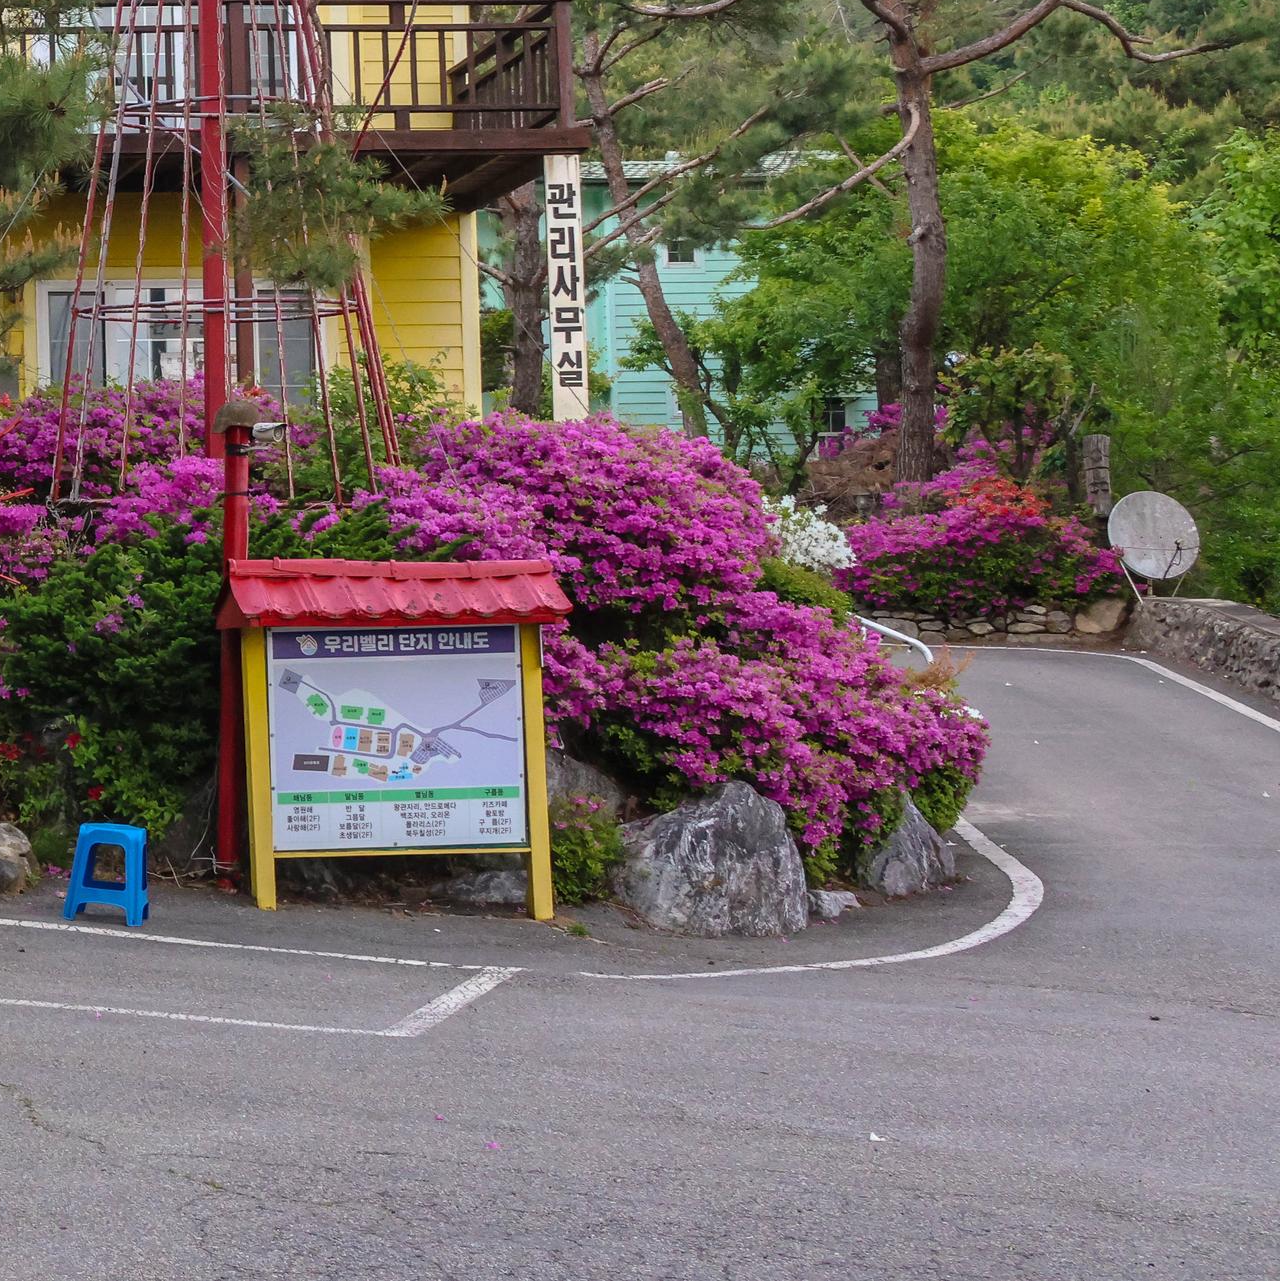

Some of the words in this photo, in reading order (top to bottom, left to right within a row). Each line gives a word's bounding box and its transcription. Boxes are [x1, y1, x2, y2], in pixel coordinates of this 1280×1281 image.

[547, 183, 583, 387] 관리사무실
[324, 634, 394, 652] 우리벨리
[398, 633, 433, 651] 단지
[438, 631, 490, 649] 안내도
